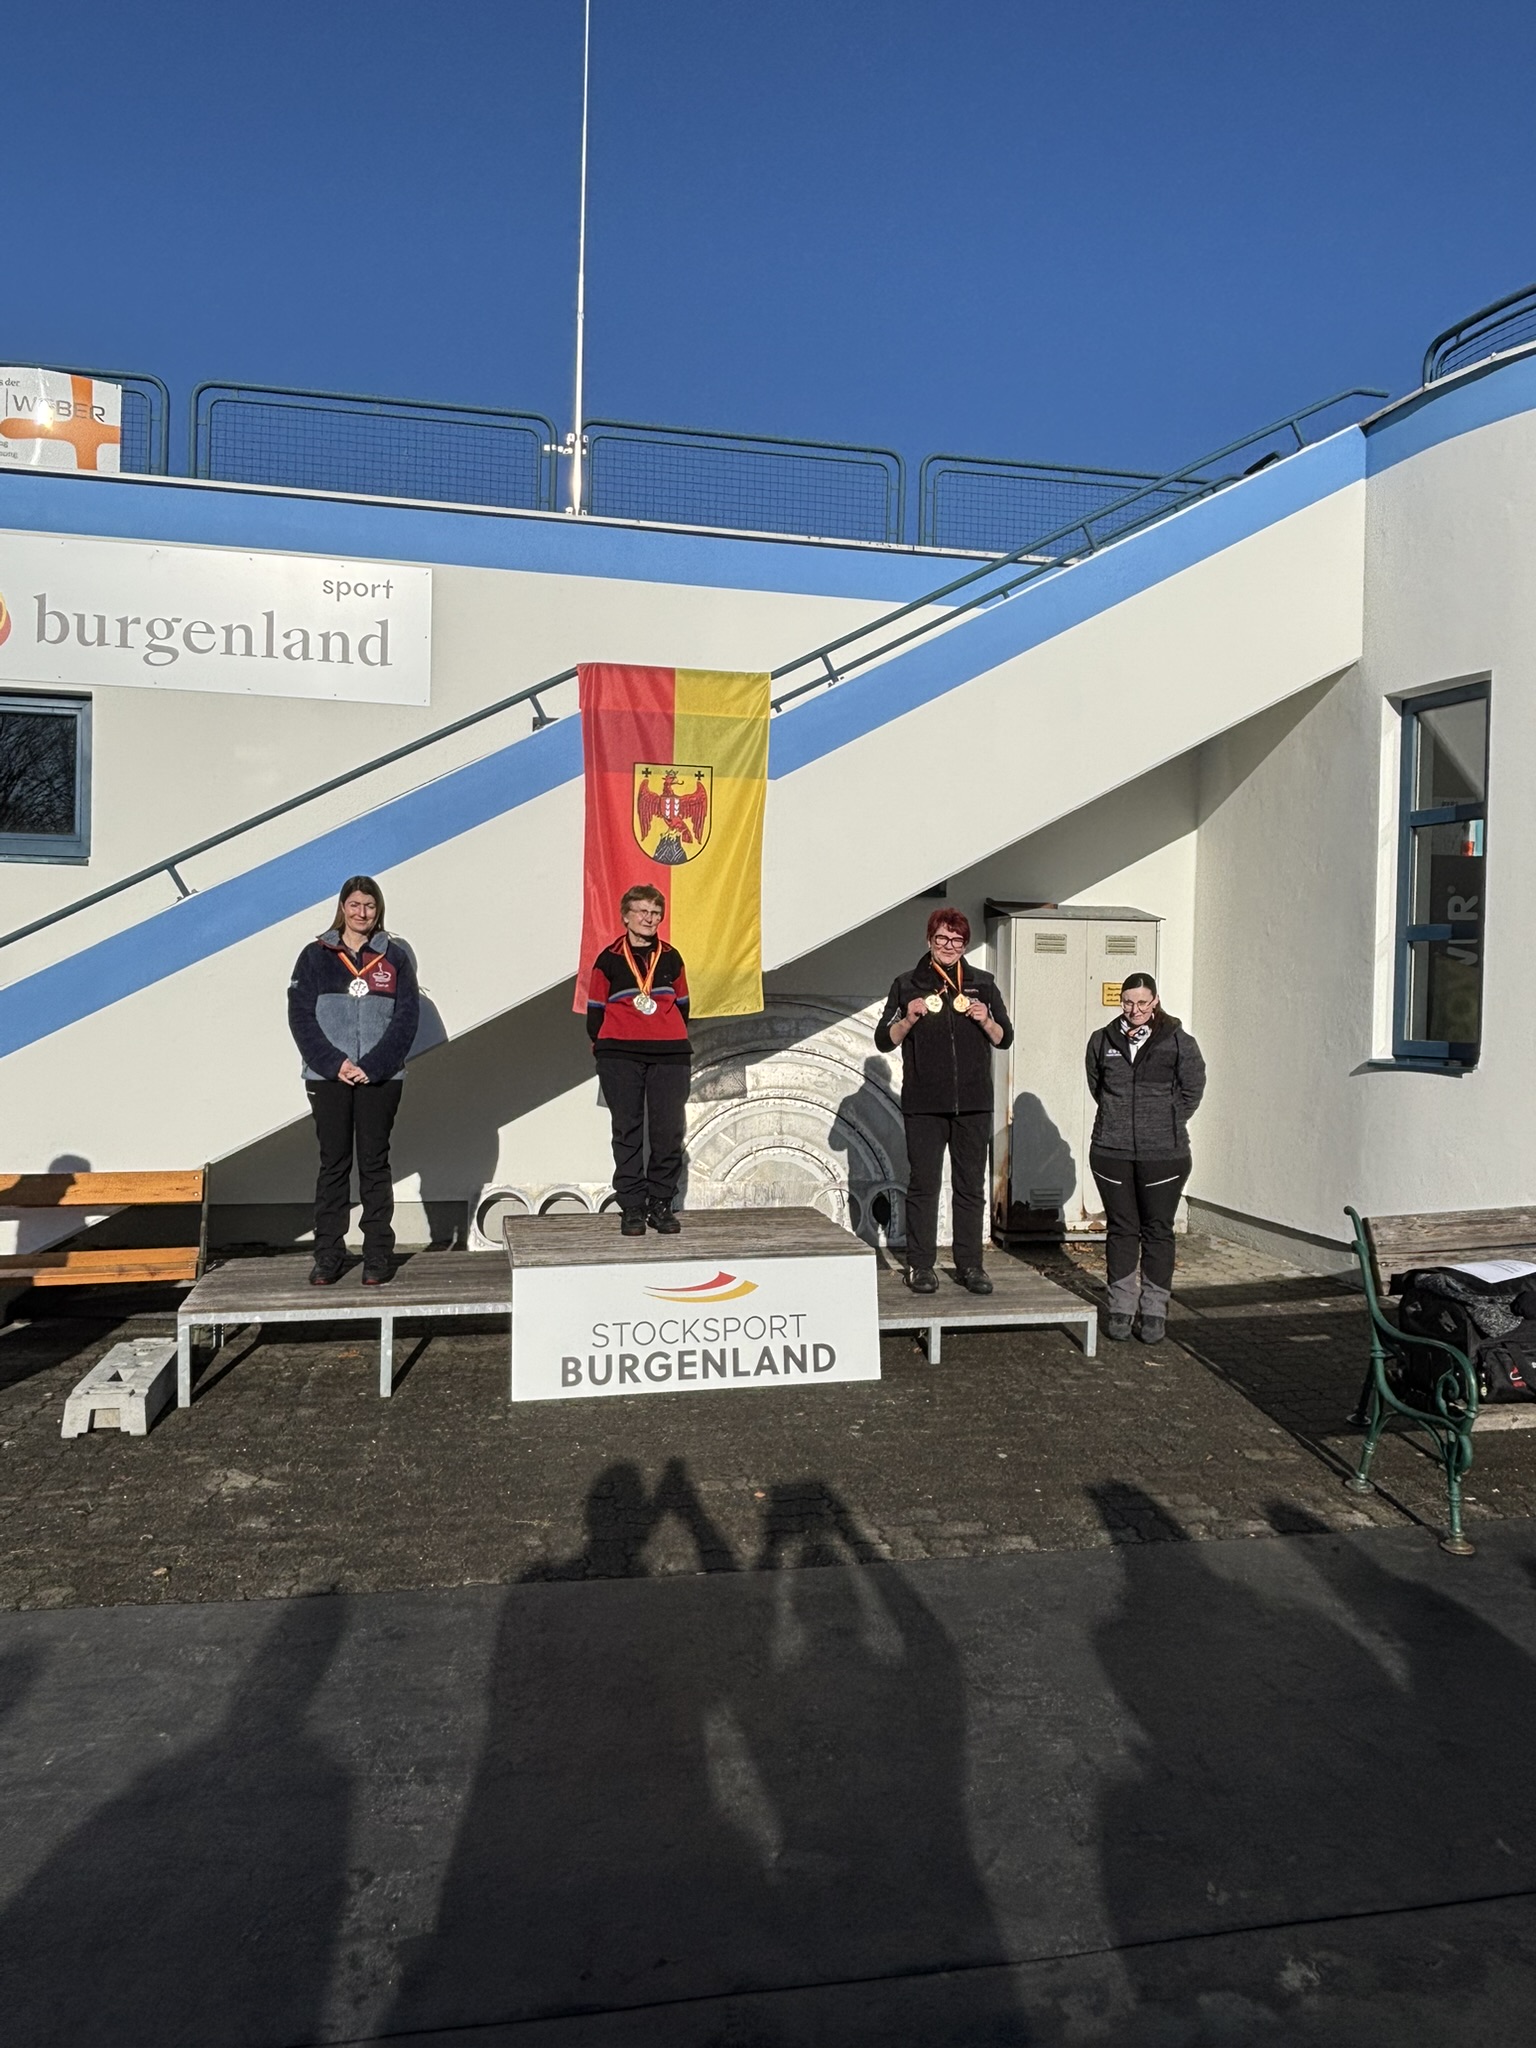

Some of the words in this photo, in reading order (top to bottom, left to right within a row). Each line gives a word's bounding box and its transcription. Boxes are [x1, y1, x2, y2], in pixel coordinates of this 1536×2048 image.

[5, 377, 21, 387] der
[12, 394, 105, 422] WBER
[322, 579, 394, 602] sport
[32, 592, 394, 667] burgenland
[592, 1314, 807, 1348] STOCKSPORT
[561, 1343, 836, 1388] BURGENLAND
